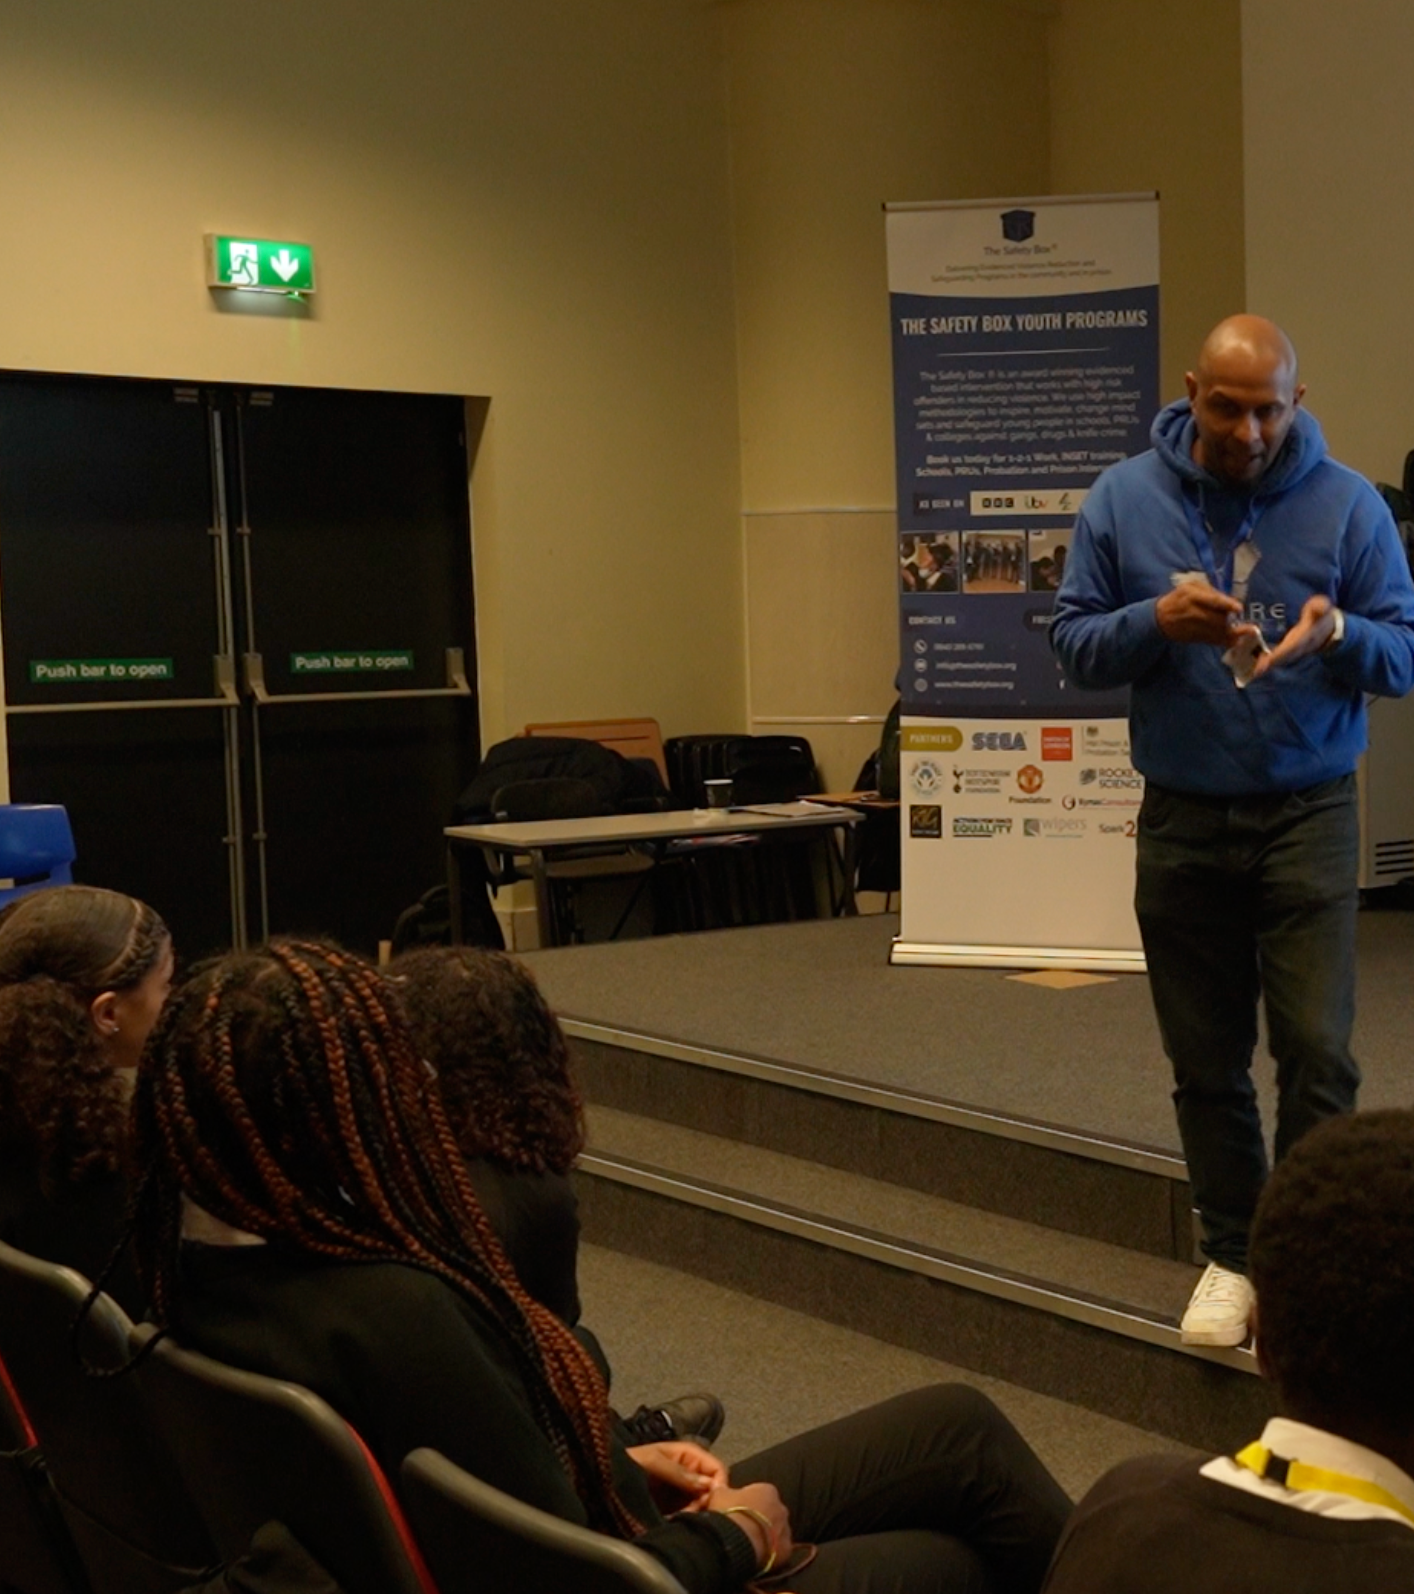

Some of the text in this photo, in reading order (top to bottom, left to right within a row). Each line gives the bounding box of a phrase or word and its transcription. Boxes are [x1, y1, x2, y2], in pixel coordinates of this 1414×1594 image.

[983, 246, 1001, 255] The
[1003, 246, 1032, 256] Safety
[900, 309, 1148, 335] THE SAFETY BOX YOUTH PROGRAMS
[919, 371, 937, 381] The
[938, 370, 966, 381] Safety
[968, 369, 985, 380] Box
[960, 382, 1013, 392] intervention
[1015, 381, 1034, 391] that
[1035, 380, 1062, 389] works
[1083, 378, 1104, 390] high
[966, 395, 1008, 405] reducing
[1086, 391, 1106, 402] high
[1107, 390, 1141, 402] impact
[987, 407, 998, 416] to
[1075, 404, 1110, 414] change
[1111, 402, 1136, 412] mind
[936, 420, 953, 429] and
[954, 418, 1001, 430] safeguard
[1002, 418, 1031, 430] young
[1032, 417, 1064, 428] people
[1076, 428, 1099, 438] knife
[926, 454, 949, 464] Book
[951, 455, 962, 464] us
[963, 453, 991, 465] today
[992, 453, 1007, 463] for
[1031, 464, 1049, 474] and
[931, 499, 951, 509] SEEN
[952, 498, 965, 508] ON
[295, 655, 409, 670] Push bar to open
[36, 663, 167, 678] Push bar to open
[909, 733, 954, 744] PARTNERS
[971, 731, 1028, 751] SEGA
[1098, 779, 1142, 790] SCIENCE
[1009, 796, 1052, 804] Foundation
[952, 823, 1013, 834] EQUALITY
[1042, 817, 1087, 832] wipers
